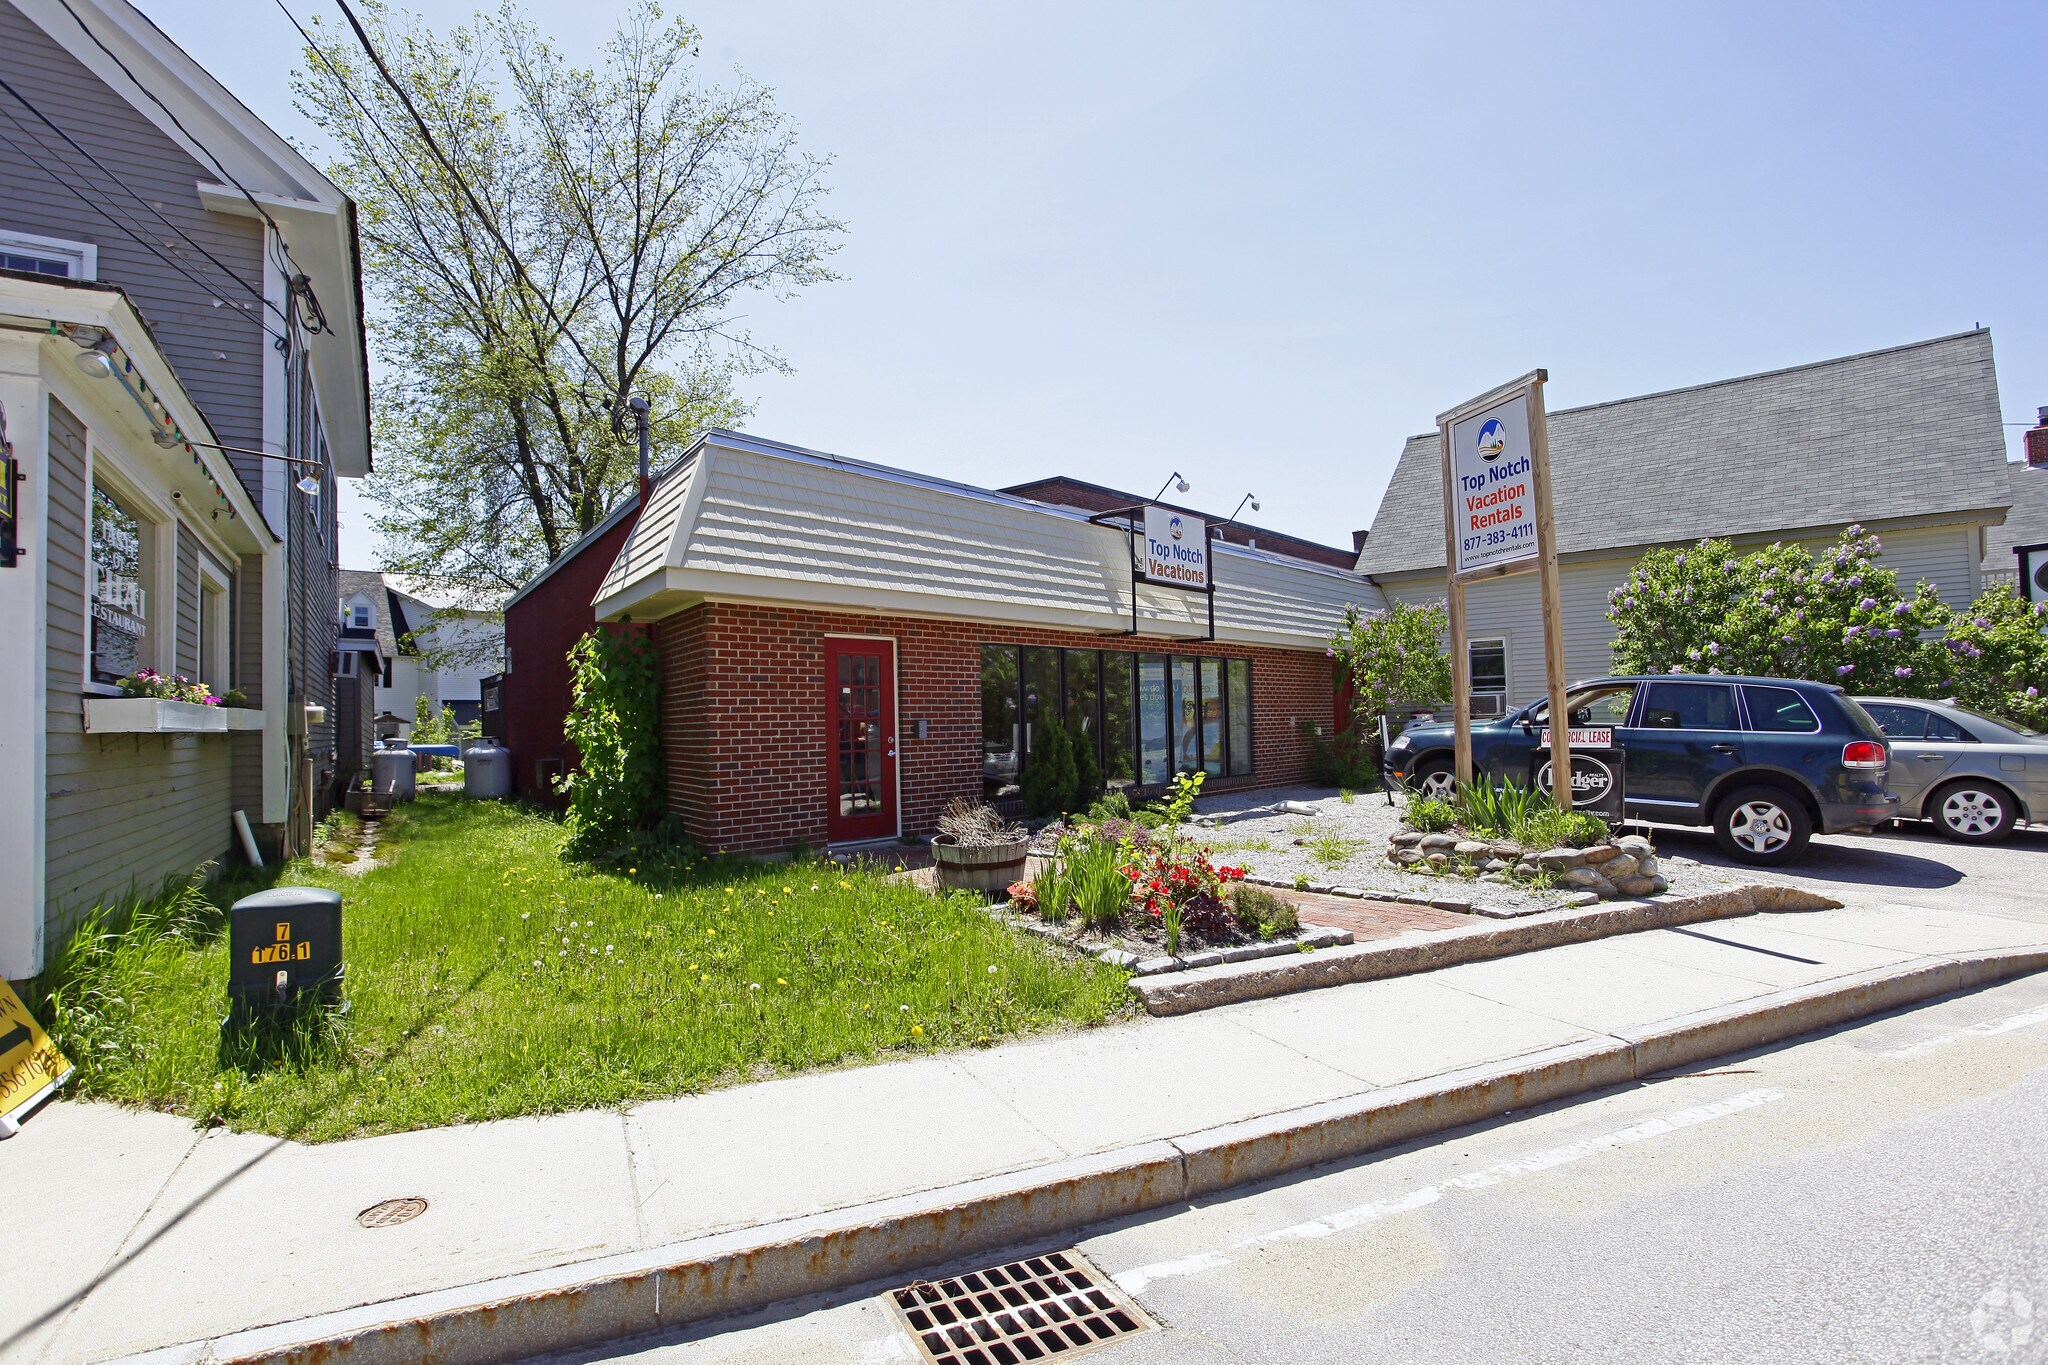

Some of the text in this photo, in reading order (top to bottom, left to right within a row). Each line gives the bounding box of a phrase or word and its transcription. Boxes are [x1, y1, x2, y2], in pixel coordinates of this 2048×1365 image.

[1461, 456, 1530, 492] Top Notch
[1466, 482, 1526, 512] Vacation
[1470, 503, 1523, 531] Rentals
[1463, 522, 1534, 551] 877-383-4111
[1148, 538, 1203, 564] Top Notch
[1464, 541, 1535, 562] www.topnotchrentals.com
[1148, 558, 1204, 584] Vacations
[91, 560, 146, 621] THAI
[1542, 731, 1610, 743] CORCIAL LEASE
[1546, 768, 1608, 791] dger
[278, 924, 289, 940] 7
